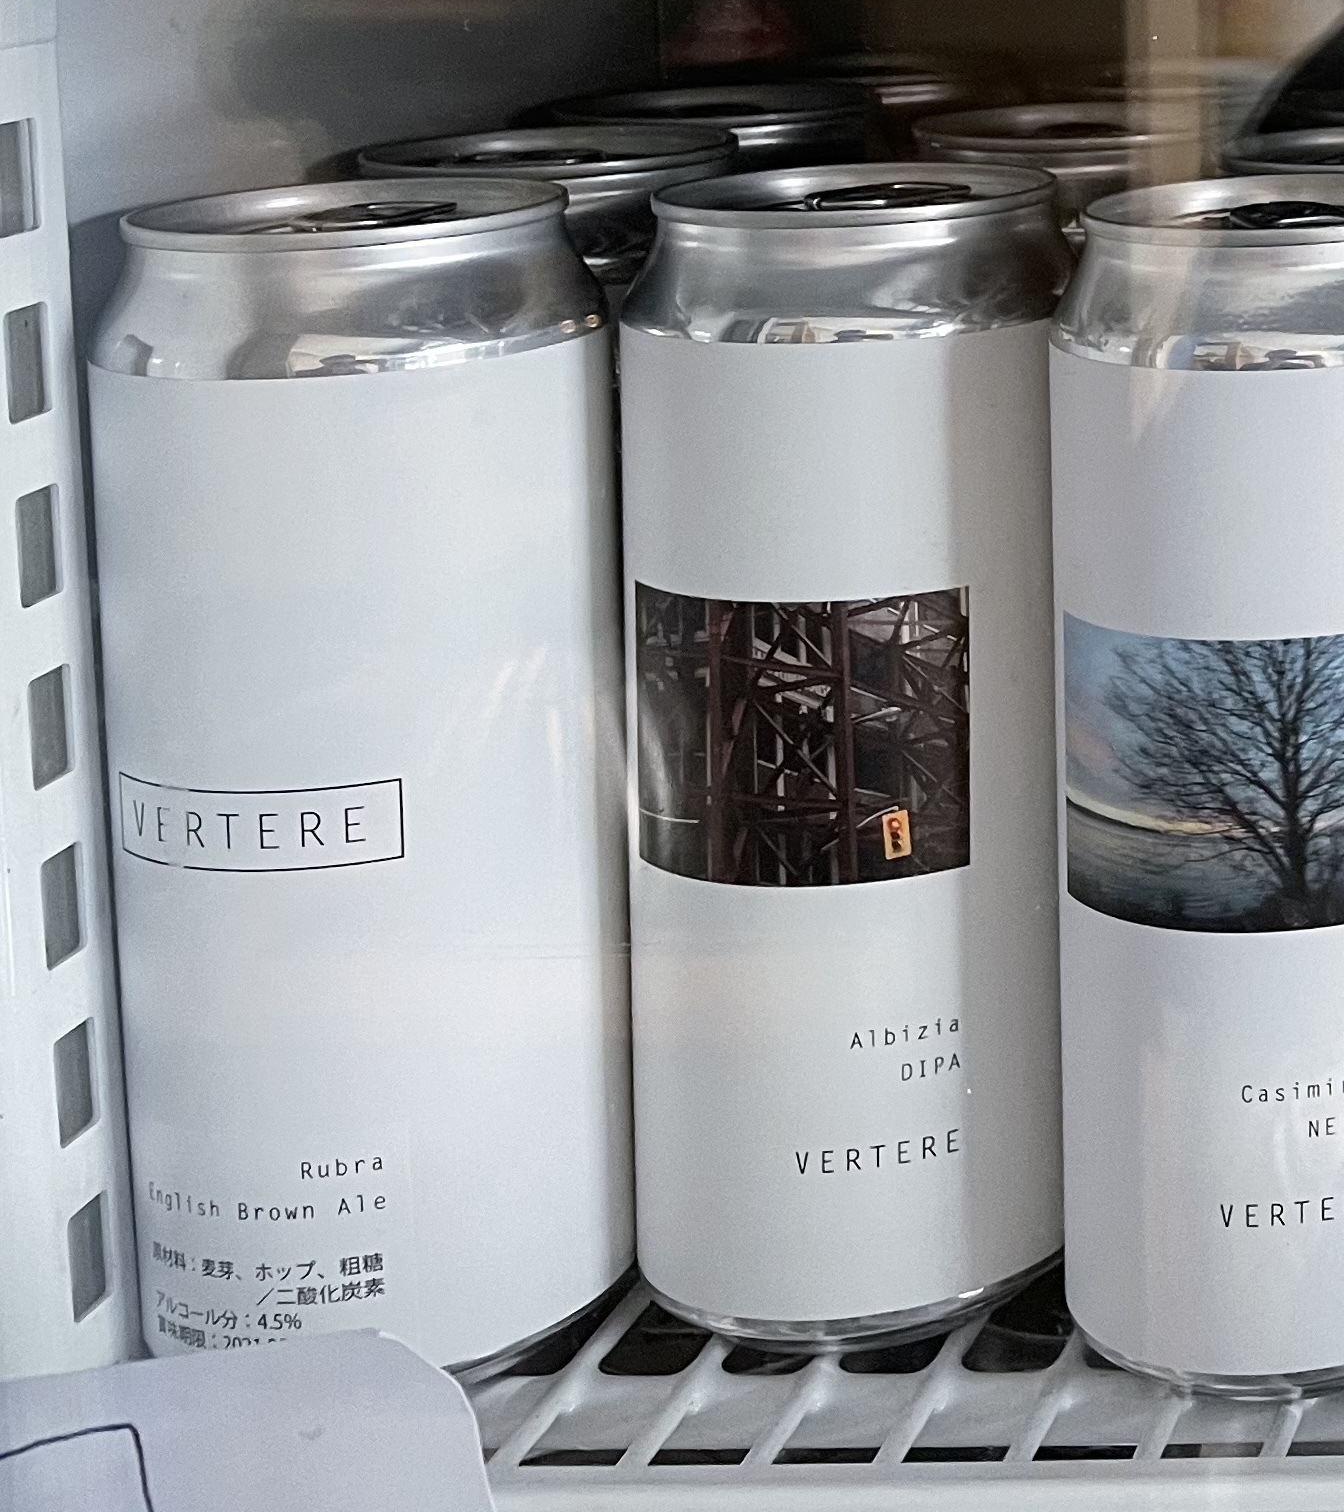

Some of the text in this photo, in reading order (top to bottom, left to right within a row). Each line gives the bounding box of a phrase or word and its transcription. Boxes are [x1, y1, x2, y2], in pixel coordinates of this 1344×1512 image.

[132, 799, 366, 850] VERTERE
[850, 1017, 960, 1050] Albizia
[901, 1053, 961, 1082] DIPA
[301, 1155, 384, 1180] Rubra
[795, 1128, 960, 1175] VERTERE
[149, 1181, 387, 1221] English Brown Ale
